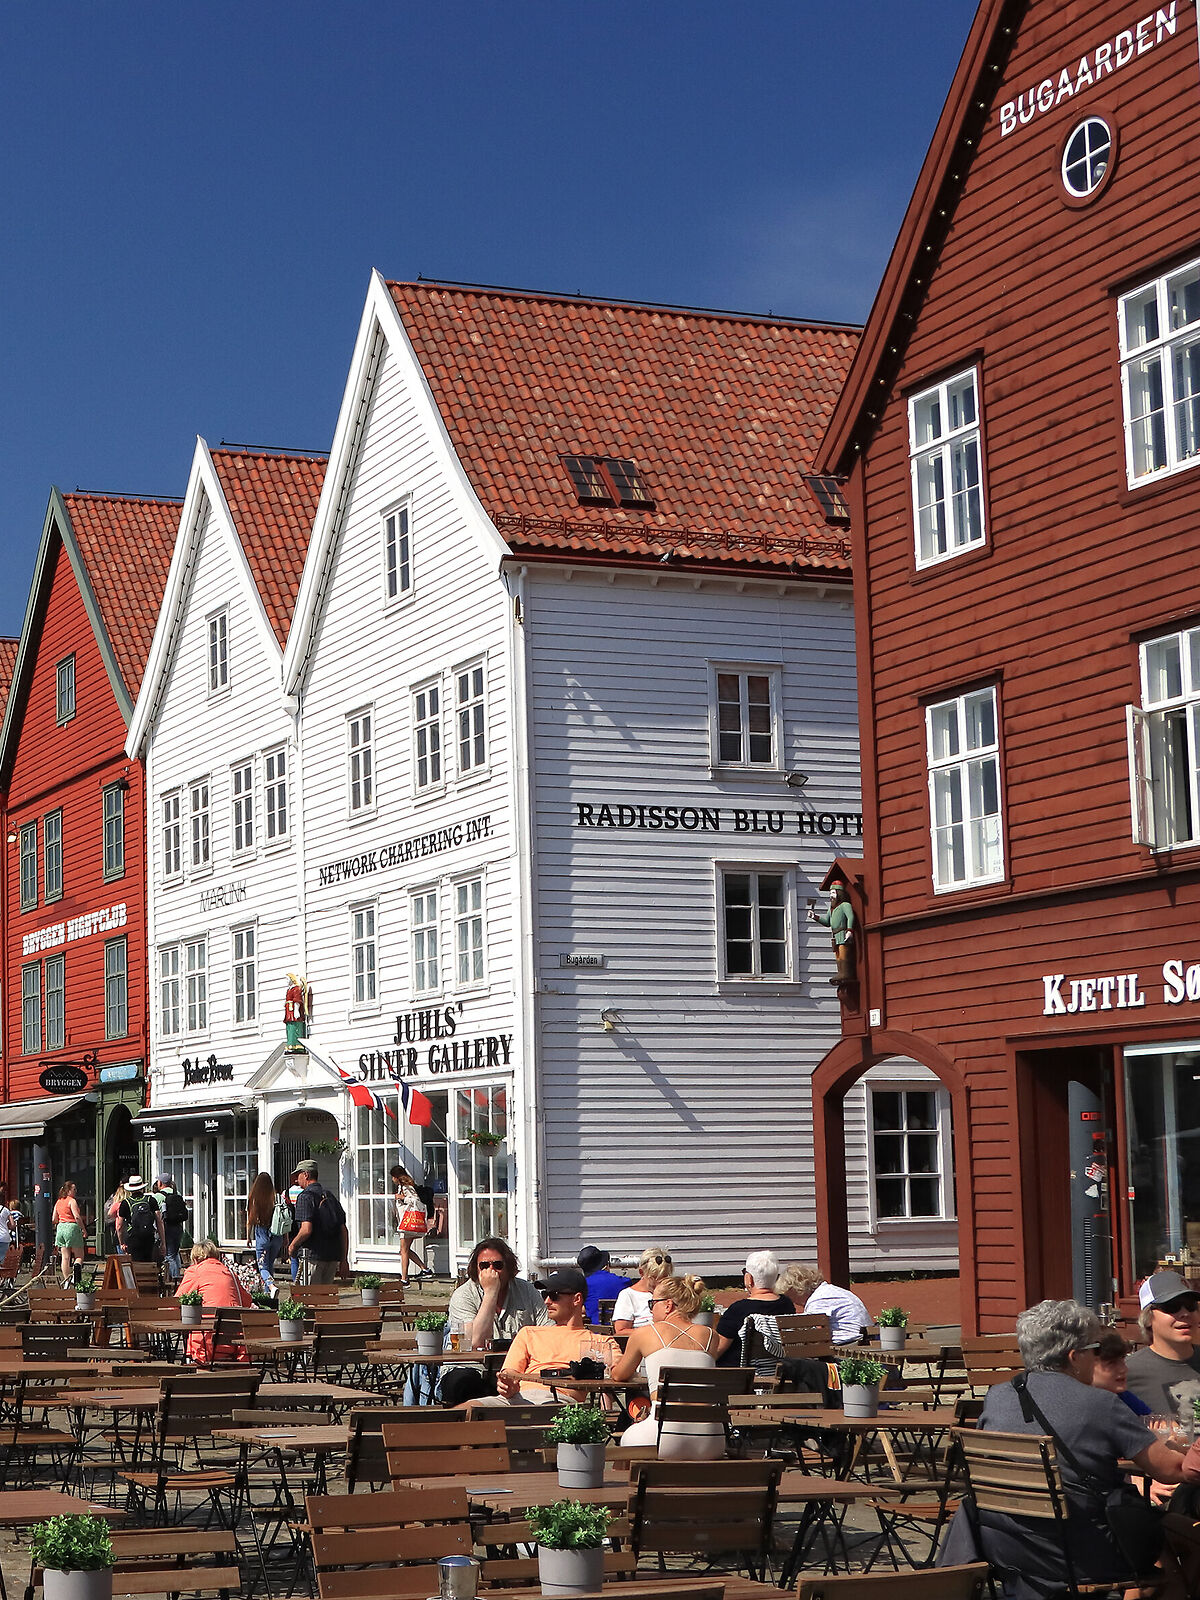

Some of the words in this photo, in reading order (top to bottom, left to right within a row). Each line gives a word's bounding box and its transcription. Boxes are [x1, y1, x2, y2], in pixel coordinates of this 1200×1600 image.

[1000, 1, 1177, 137] BUGAARDEN
[577, 803, 720, 831] RADISSON
[733, 808, 784, 832] BLU
[319, 852, 377, 886] NETWORK
[379, 824, 463, 868] CHARTERING
[466, 815, 494, 843] INT.
[22, 922, 65, 956] BRYGGEN
[66, 902, 128, 942] NIGHTCLUB
[566, 955, 598, 966] Bugården
[1042, 973, 1145, 1016] KJETIL
[358, 1047, 418, 1081] SILVER
[428, 1034, 513, 1074] GALLERY
